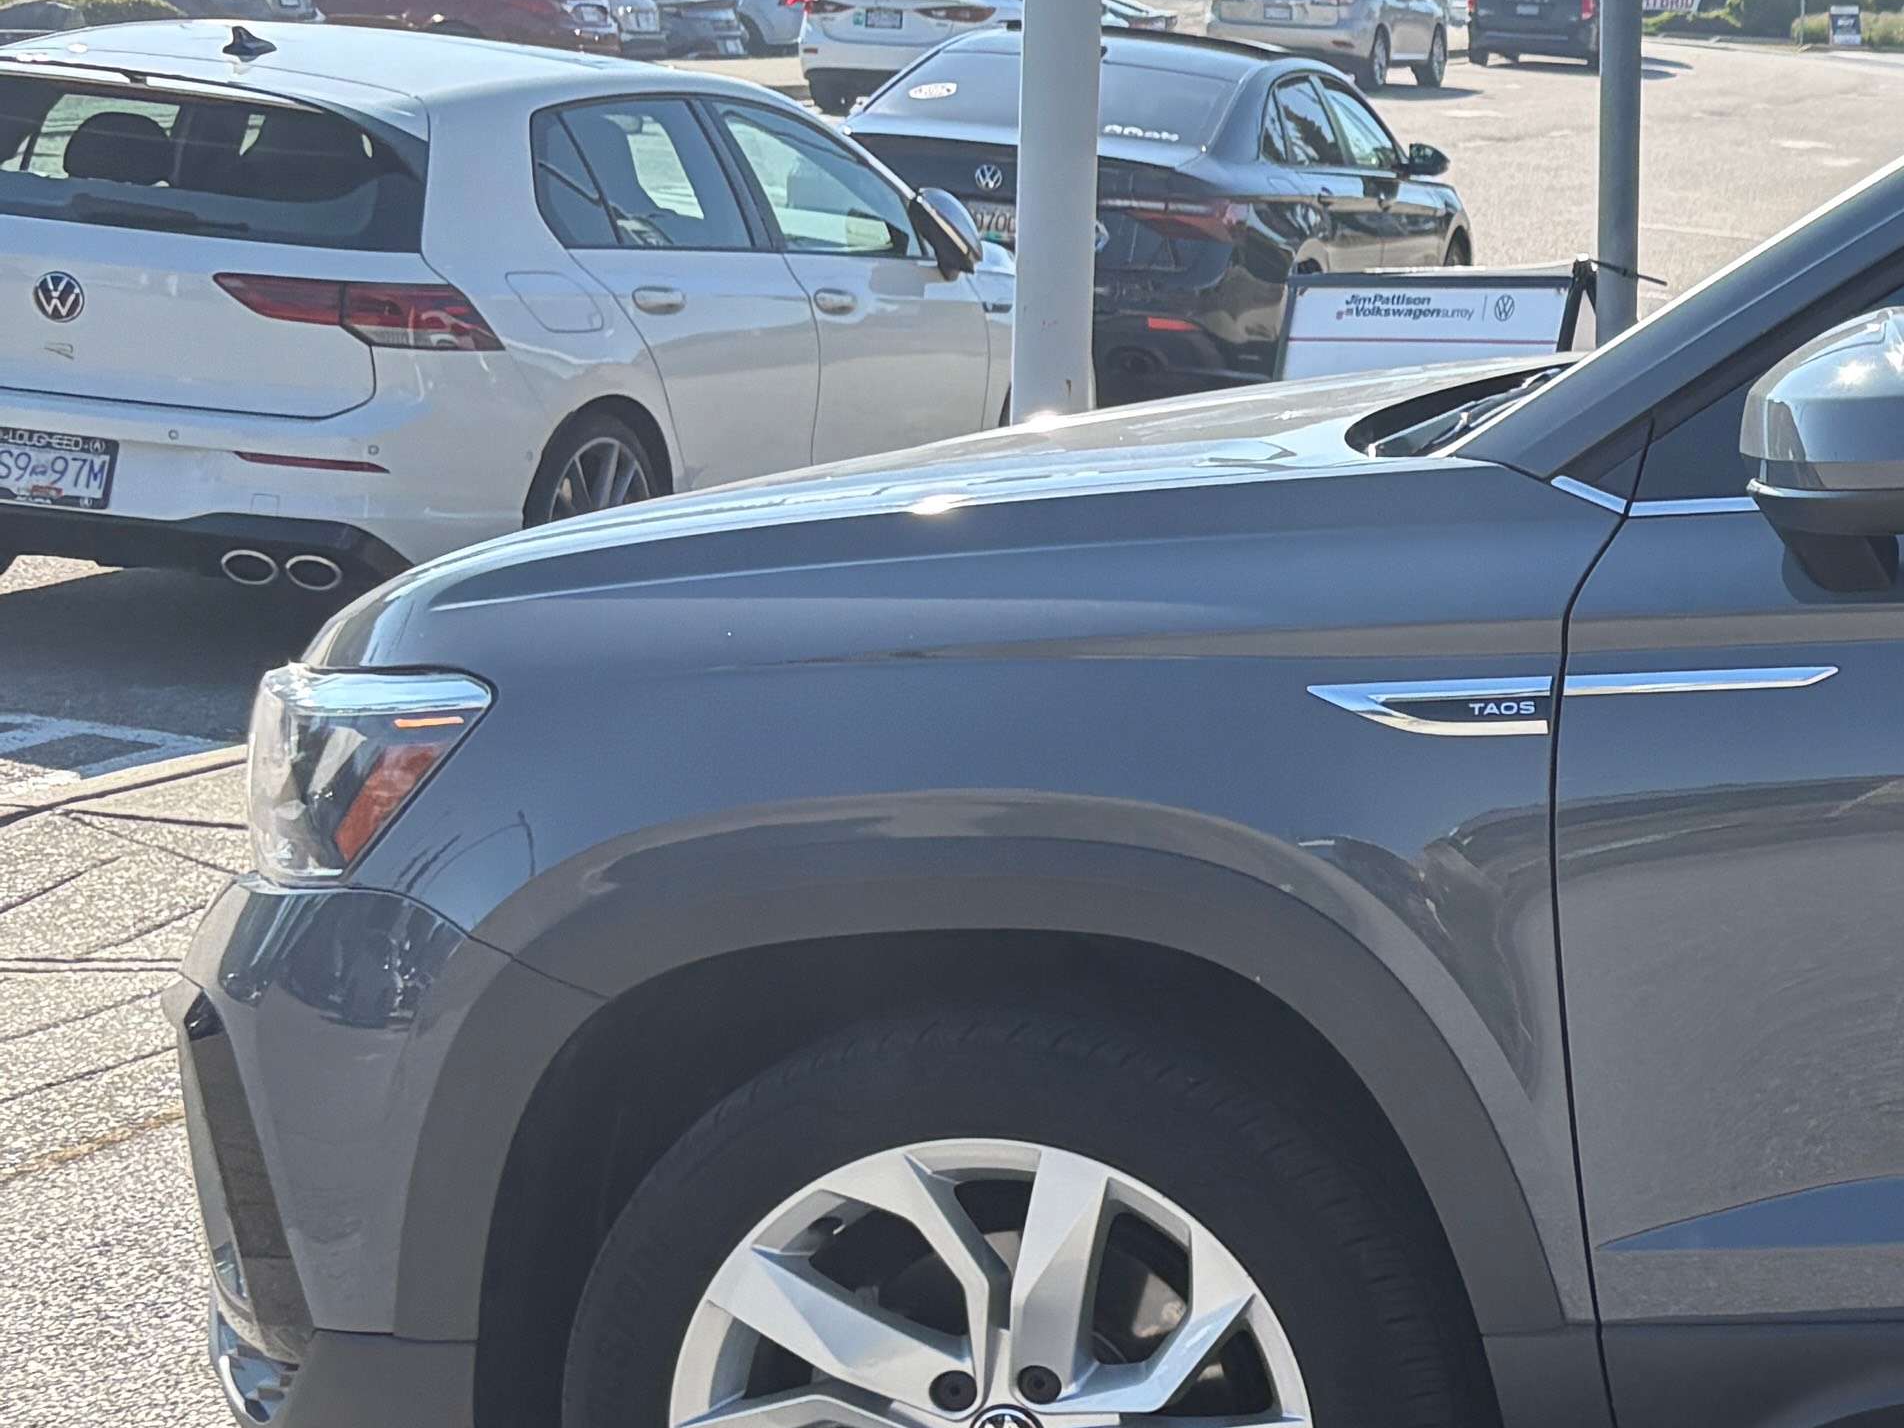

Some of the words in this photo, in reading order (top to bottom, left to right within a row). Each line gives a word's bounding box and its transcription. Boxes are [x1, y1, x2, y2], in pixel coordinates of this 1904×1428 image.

[34, 271, 85, 323] VW
[51, 455, 107, 490] 97M
[1469, 701, 1536, 716] TAOS
